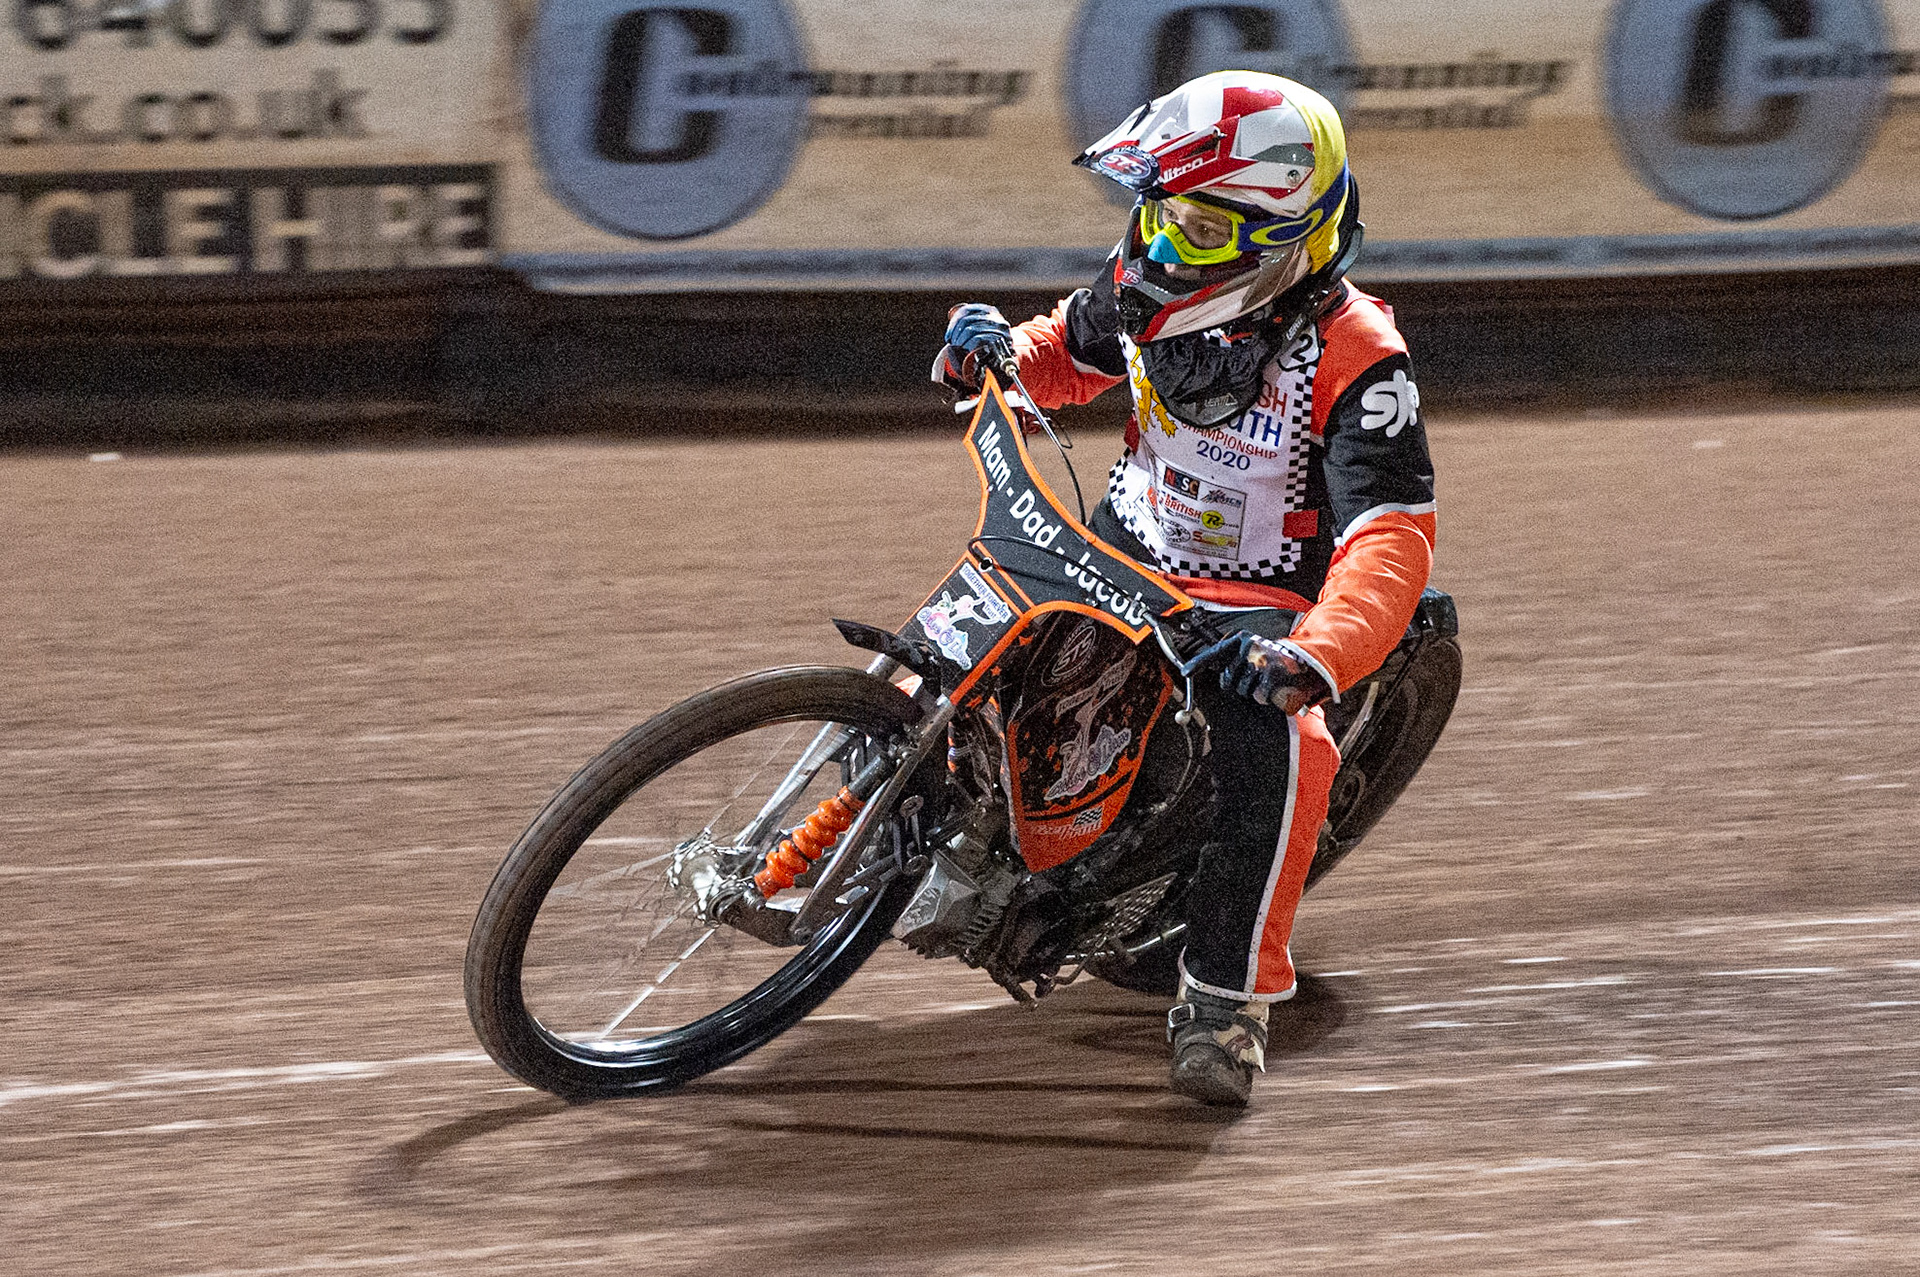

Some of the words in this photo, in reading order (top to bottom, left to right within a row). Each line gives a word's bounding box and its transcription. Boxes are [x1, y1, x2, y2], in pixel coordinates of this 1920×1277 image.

[1158, 157, 1204, 184] Nitro
[1291, 333, 1315, 364] 2
[1196, 440, 1251, 471] 2020
[1165, 497, 1202, 519] BRITISH
[978, 421, 1012, 492] Mam
[1008, 489, 1063, 547] Dad
[1064, 552, 1148, 627] Jacob
[962, 566, 987, 597] TOGETHER
[986, 591, 1009, 620] FOREVER
